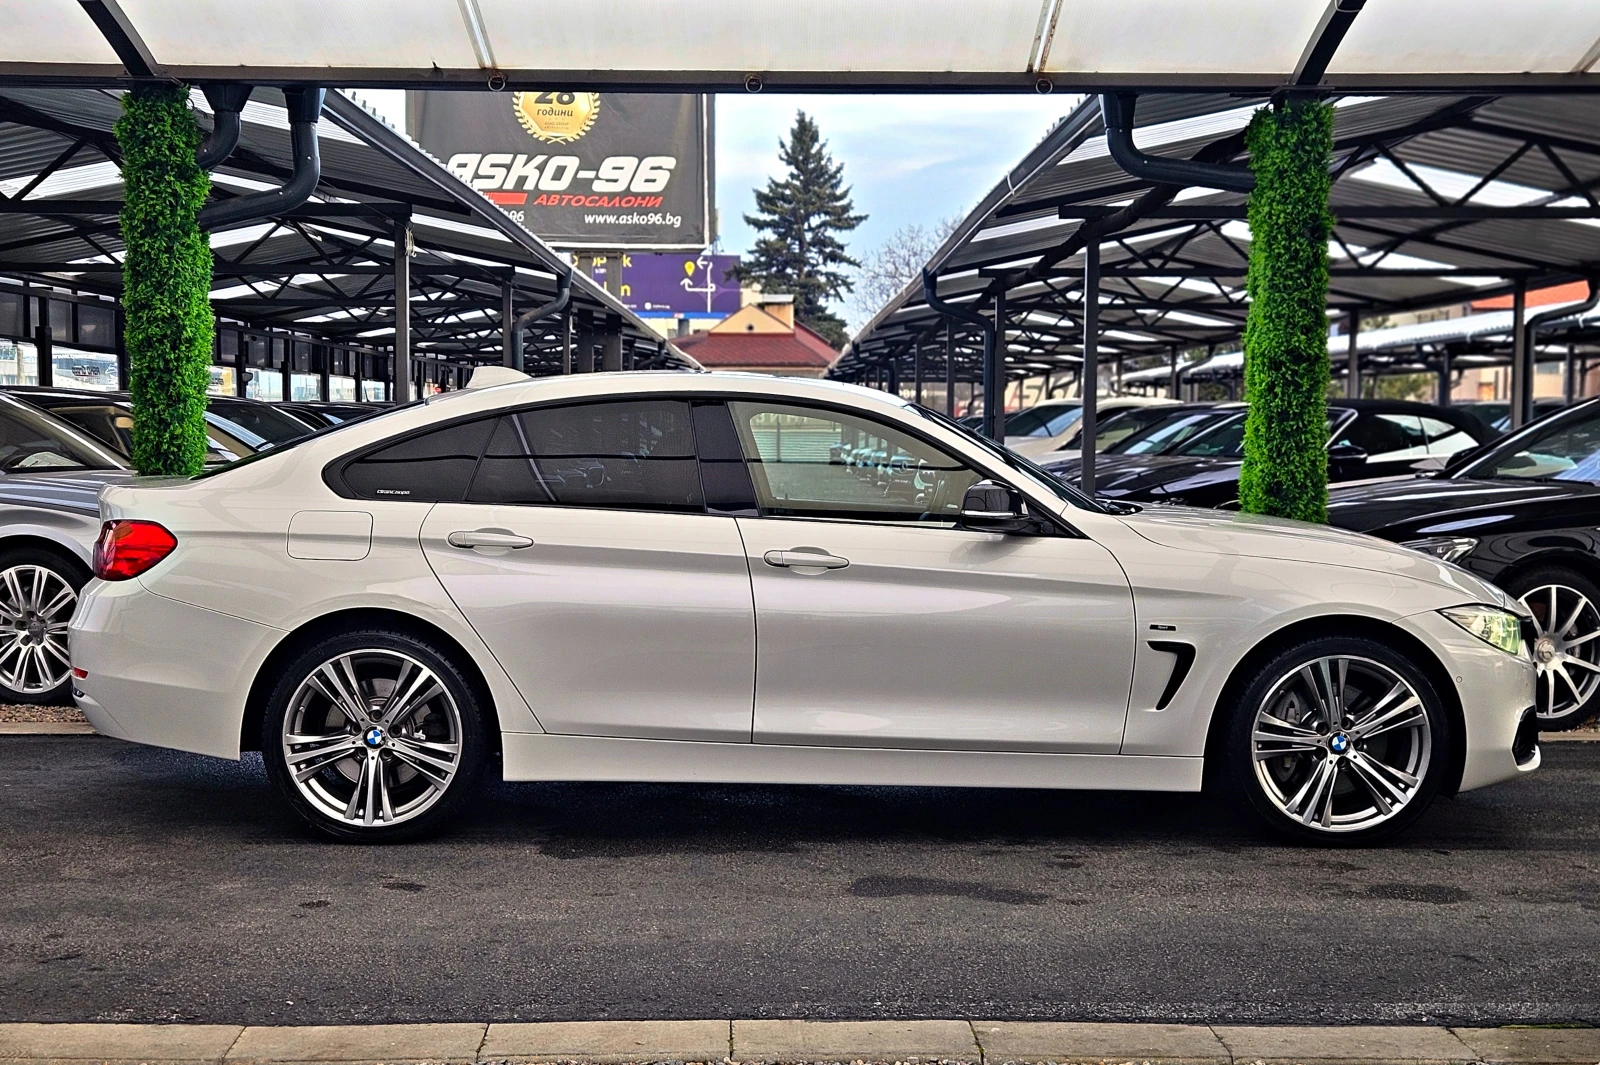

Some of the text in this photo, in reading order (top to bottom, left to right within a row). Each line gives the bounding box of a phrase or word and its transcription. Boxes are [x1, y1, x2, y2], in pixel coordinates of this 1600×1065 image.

[536, 107, 574, 117] години
[447, 153, 677, 193] ASKO-96
[533, 193, 664, 208] АВТОСАЛОНИ
[584, 211, 682, 228] www.asko96.bg
